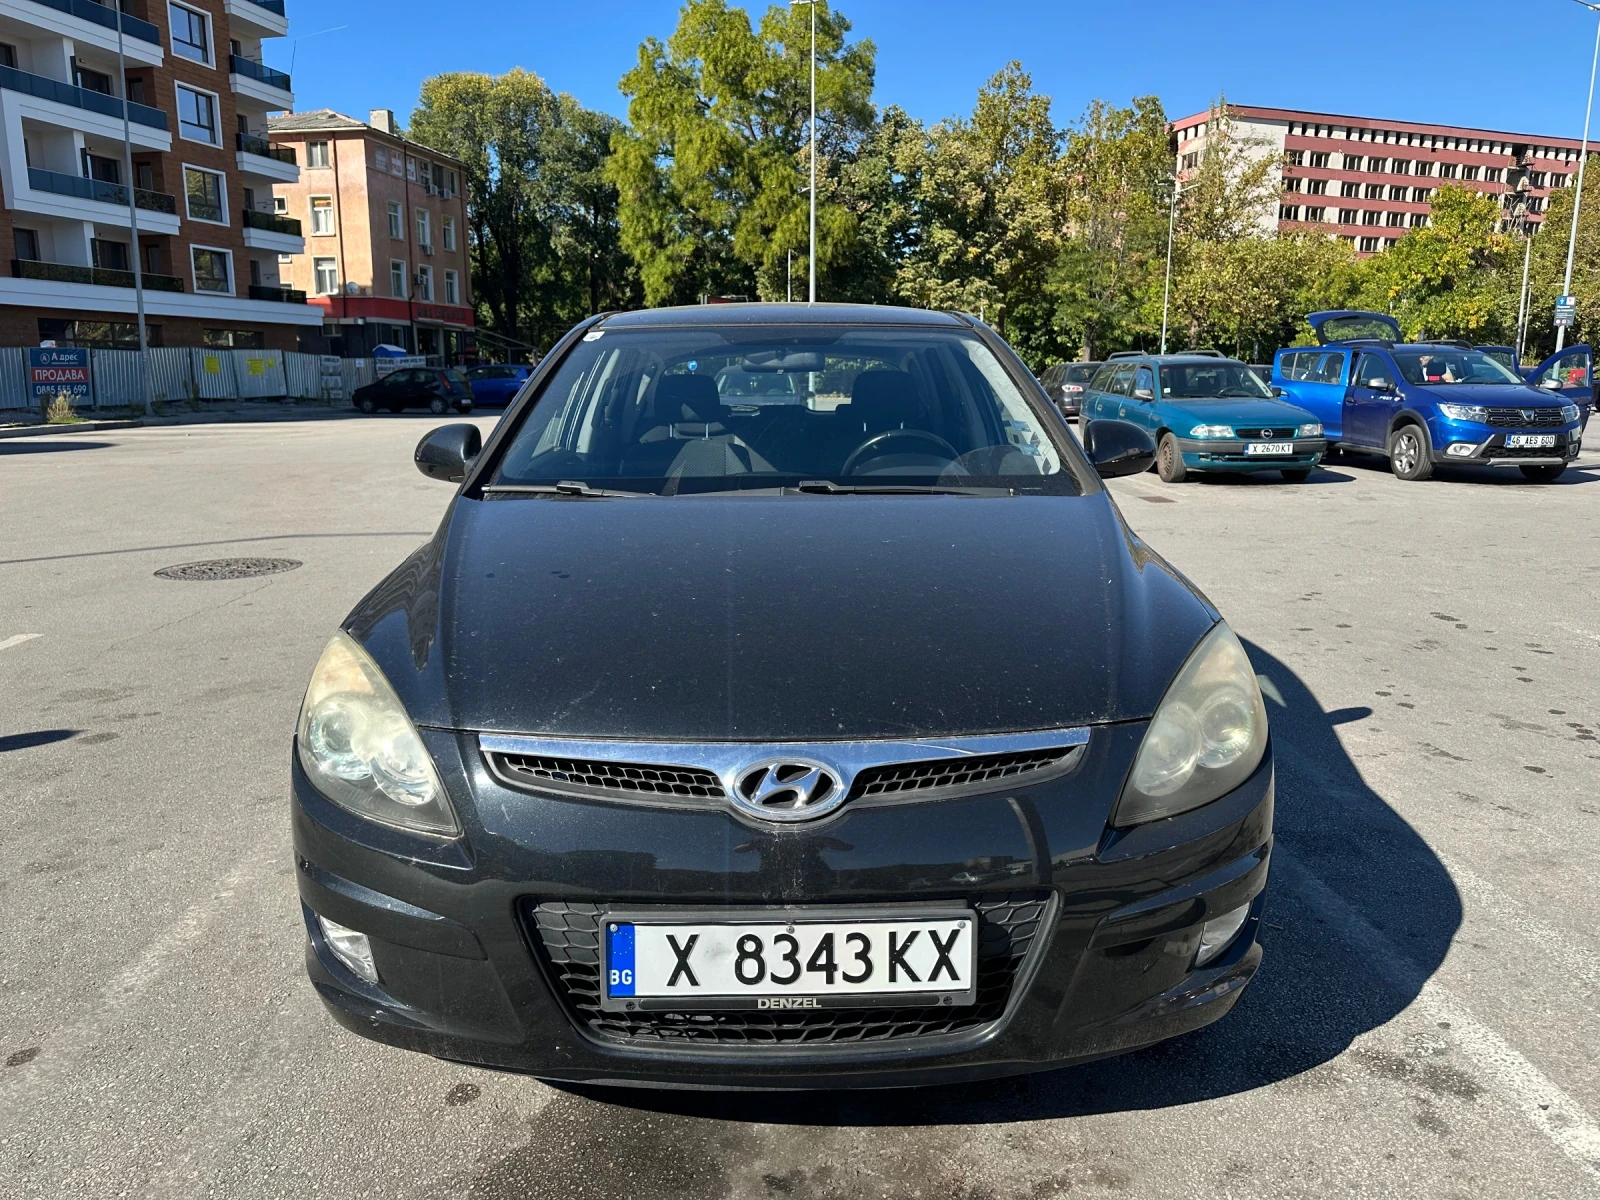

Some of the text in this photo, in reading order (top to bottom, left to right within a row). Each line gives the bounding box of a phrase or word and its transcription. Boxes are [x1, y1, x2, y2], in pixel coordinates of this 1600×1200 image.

[35, 369, 84, 382] ПРОДАВА
[36, 385, 56, 395] 0885
[73, 384, 87, 394] 699
[1511, 436, 1520, 444] 46
[1525, 436, 1538, 444] AES
[1541, 436, 1553, 444] 600
[666, 934, 700, 986] X
[609, 969, 632, 985] BG
[757, 997, 822, 1009] DENZEL
